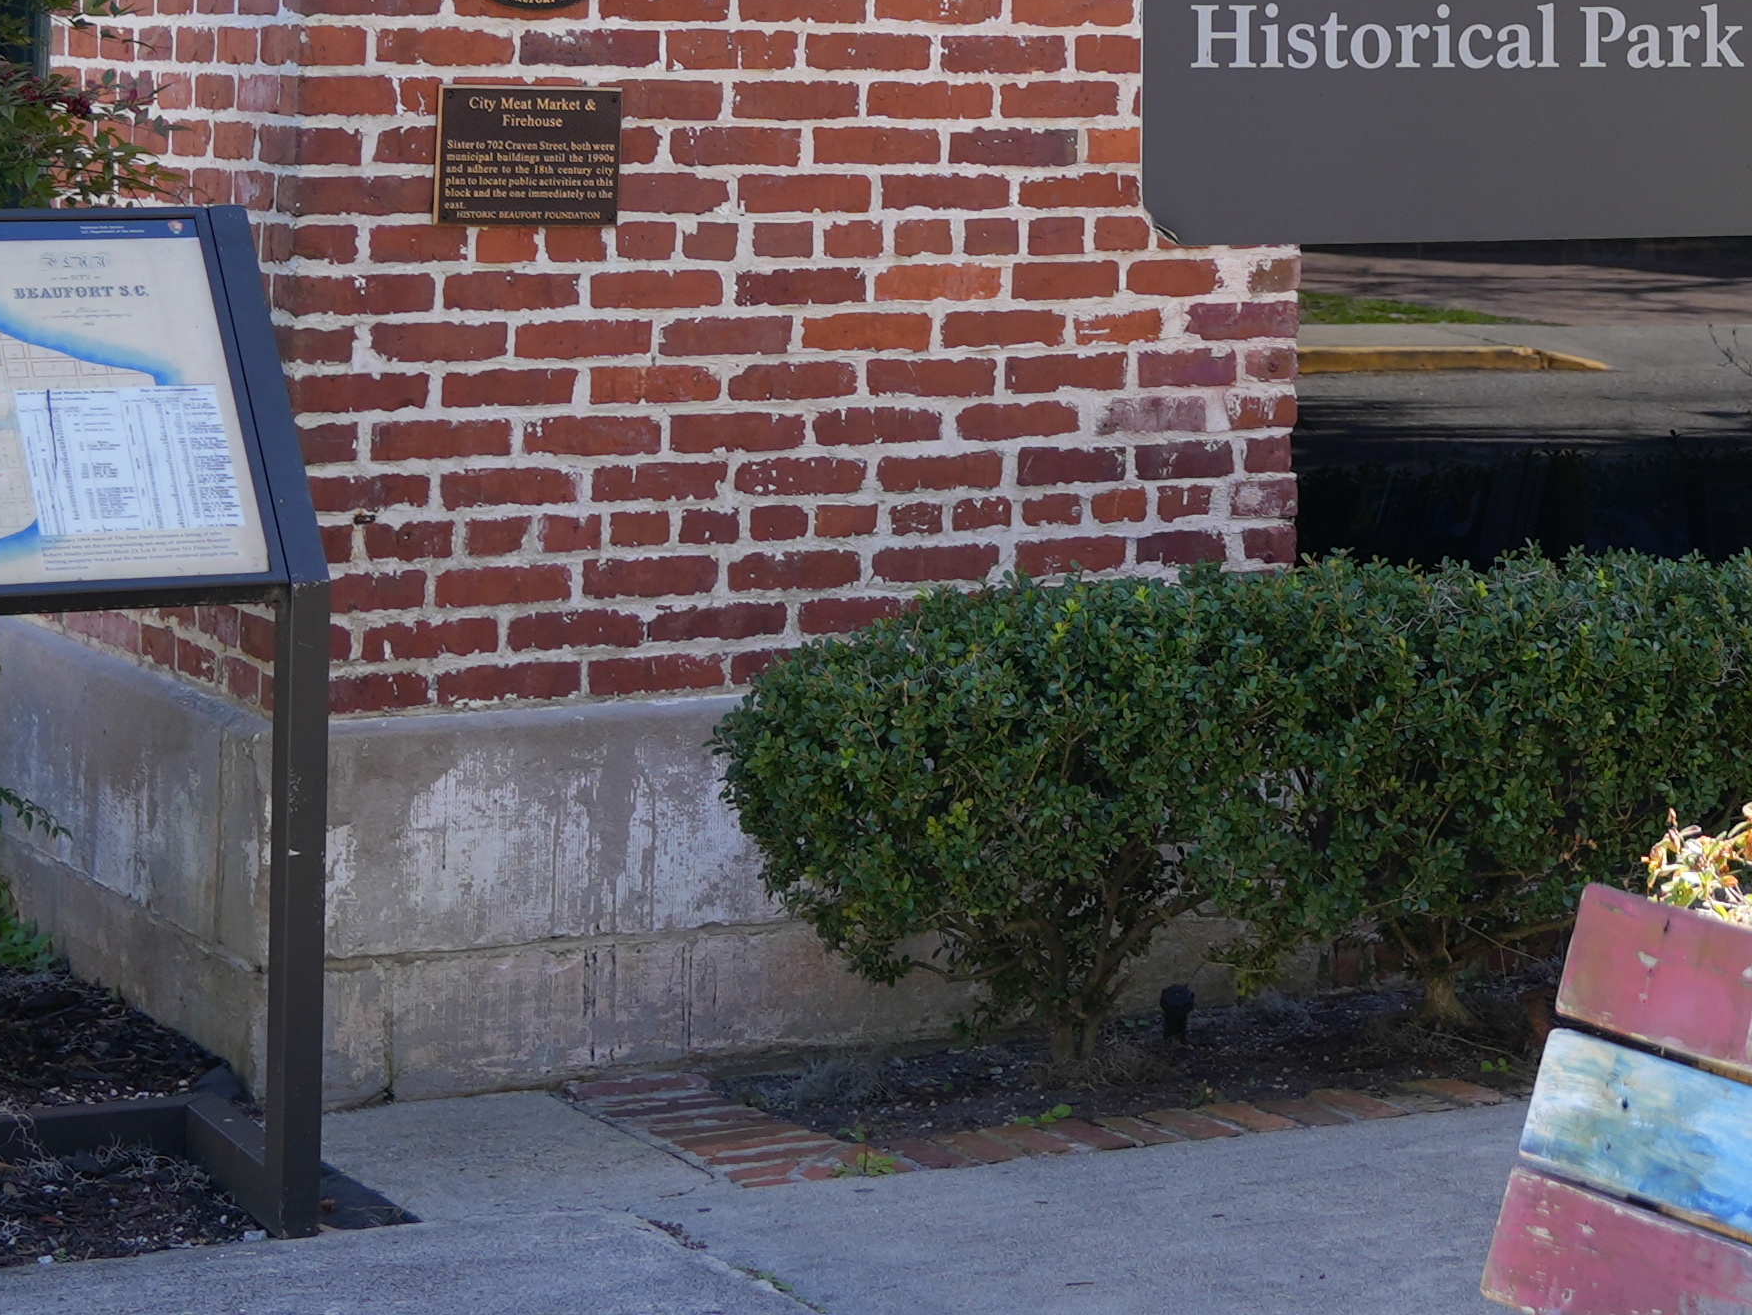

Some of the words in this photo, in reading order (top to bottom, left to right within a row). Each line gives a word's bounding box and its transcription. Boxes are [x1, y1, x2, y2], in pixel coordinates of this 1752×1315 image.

[1190, 2, 1560, 71] Historical
[1579, 2, 1745, 69] Park
[469, 96, 496, 112] City
[501, 97, 532, 110] Meat
[537, 98, 580, 110] Market
[585, 98, 596, 111] &
[502, 114, 563, 127] Firehouse
[447, 140, 474, 149] Sister
[476, 141, 485, 149] to
[487, 140, 503, 149] 702
[505, 141, 537, 150] Craven
[539, 141, 568, 151] Street,
[571, 142, 591, 150] both
[446, 153, 493, 163] municipal
[497, 153, 540, 164] buildings
[544, 153, 565, 162] until
[569, 154, 583, 162] the
[588, 154, 615, 163] 1990s
[446, 164, 463, 173] and
[467, 164, 498, 173] adhere
[502, 165, 511, 173] to
[515, 165, 530, 174] the
[535, 165, 554, 174] 18th
[558, 167, 592, 176] century
[596, 166, 614, 177] city
[445, 176, 466, 187] plan
[468, 177, 477, 185] to
[479, 176, 506, 185] locate
[508, 177, 537, 188] public
[539, 177, 581, 186] activities
[596, 177, 613, 186] this
[445, 188, 471, 197] block
[474, 189, 490, 198] and
[492, 188, 507, 198] the
[529, 188, 585, 200] immediately
[587, 190, 596, 198] to
[599, 190, 613, 198] the
[456, 211, 498, 219] HISTORIC
[499, 211, 542, 219] BEAUFORT
[545, 211, 600, 219] FOUNDATION
[13, 286, 114, 299] BEAUFORT
[119, 285, 149, 297] S.C.
